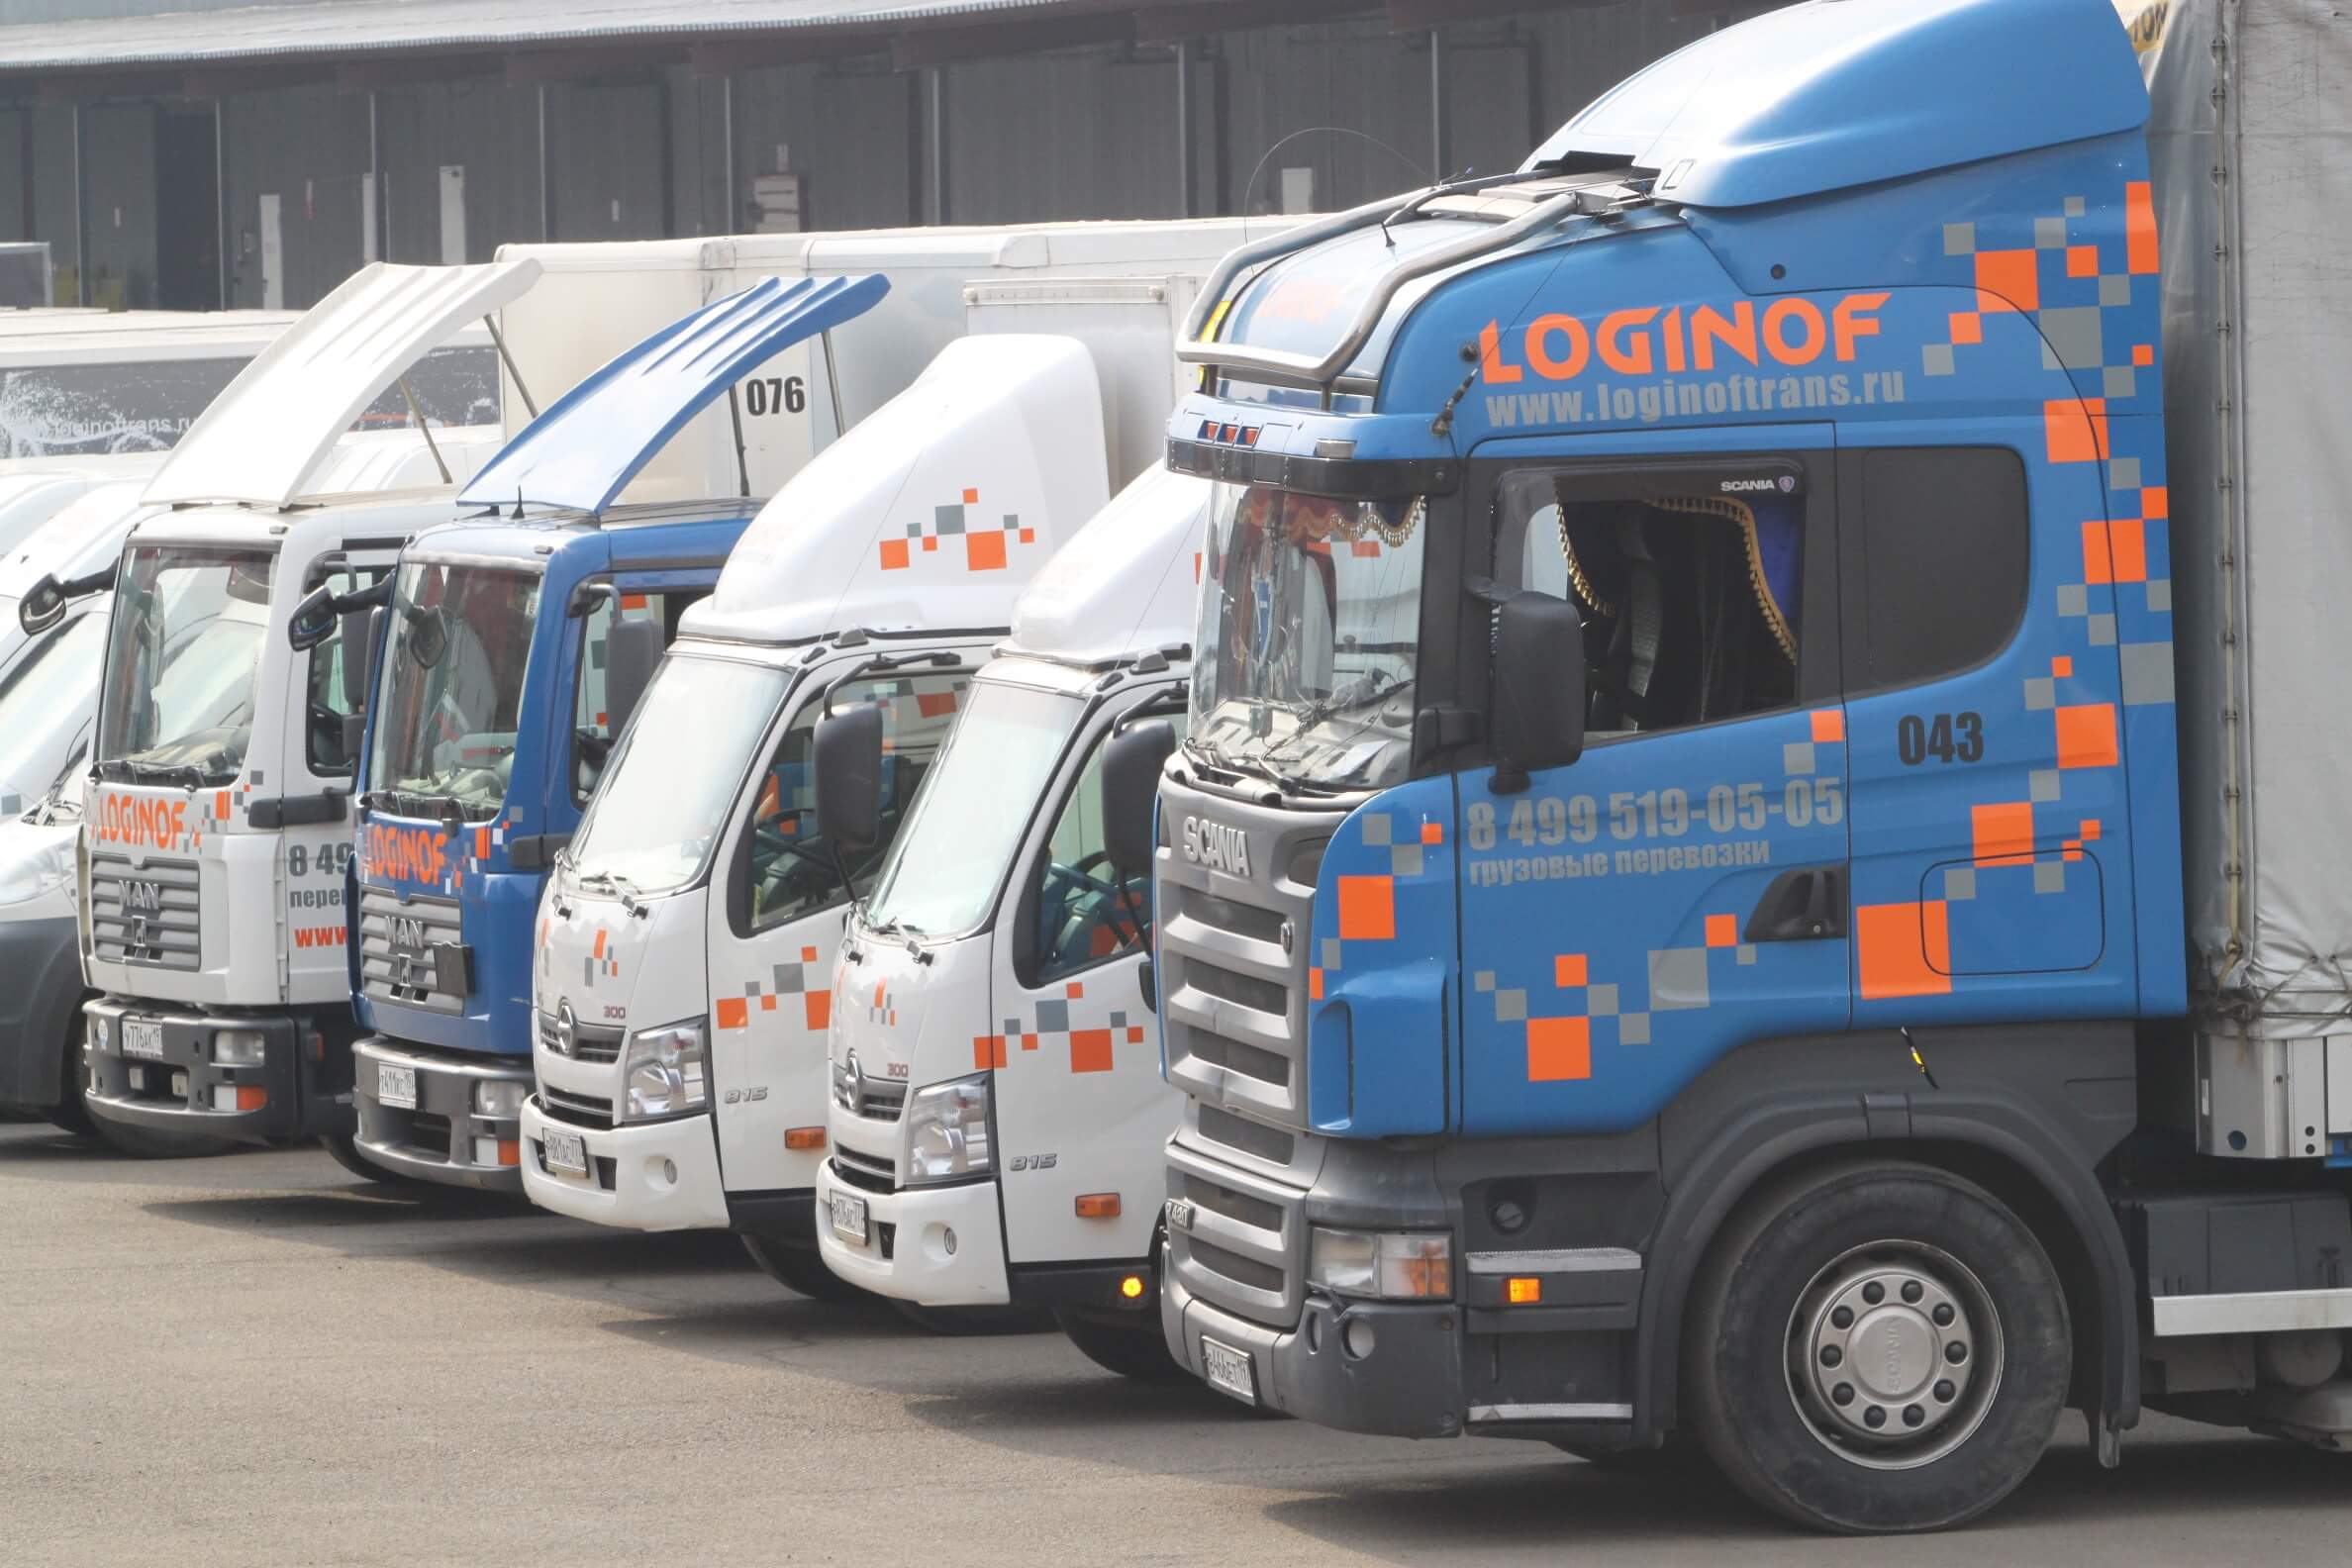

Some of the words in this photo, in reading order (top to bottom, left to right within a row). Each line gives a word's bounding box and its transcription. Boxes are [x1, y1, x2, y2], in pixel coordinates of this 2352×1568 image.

[1479, 292, 1892, 384] LOGINOF
[746, 376, 805, 416] 076
[1485, 371, 1906, 428] www.loginoftrans.ru
[1720, 479, 1775, 492] SCANIA
[1899, 712, 1984, 765] 043
[99, 793, 187, 851] LOGINOF
[1467, 802, 1496, 850] 8
[1508, 794, 1599, 846] 499
[1609, 776, 1844, 840] 519-05-05
[289, 844, 308, 877] 8
[365, 823, 446, 886] LOGINOF
[1183, 816, 1251, 877] SCANIA
[1469, 855, 1609, 888] грузовые
[1615, 840, 1770, 877] перевозки
[119, 879, 159, 911] MAN
[385, 915, 423, 948] MAN
[603, 1005, 626, 1020] 300
[887, 1062, 909, 1078] 300
[725, 1086, 768, 1104] 815
[1010, 1153, 1057, 1172] 815
